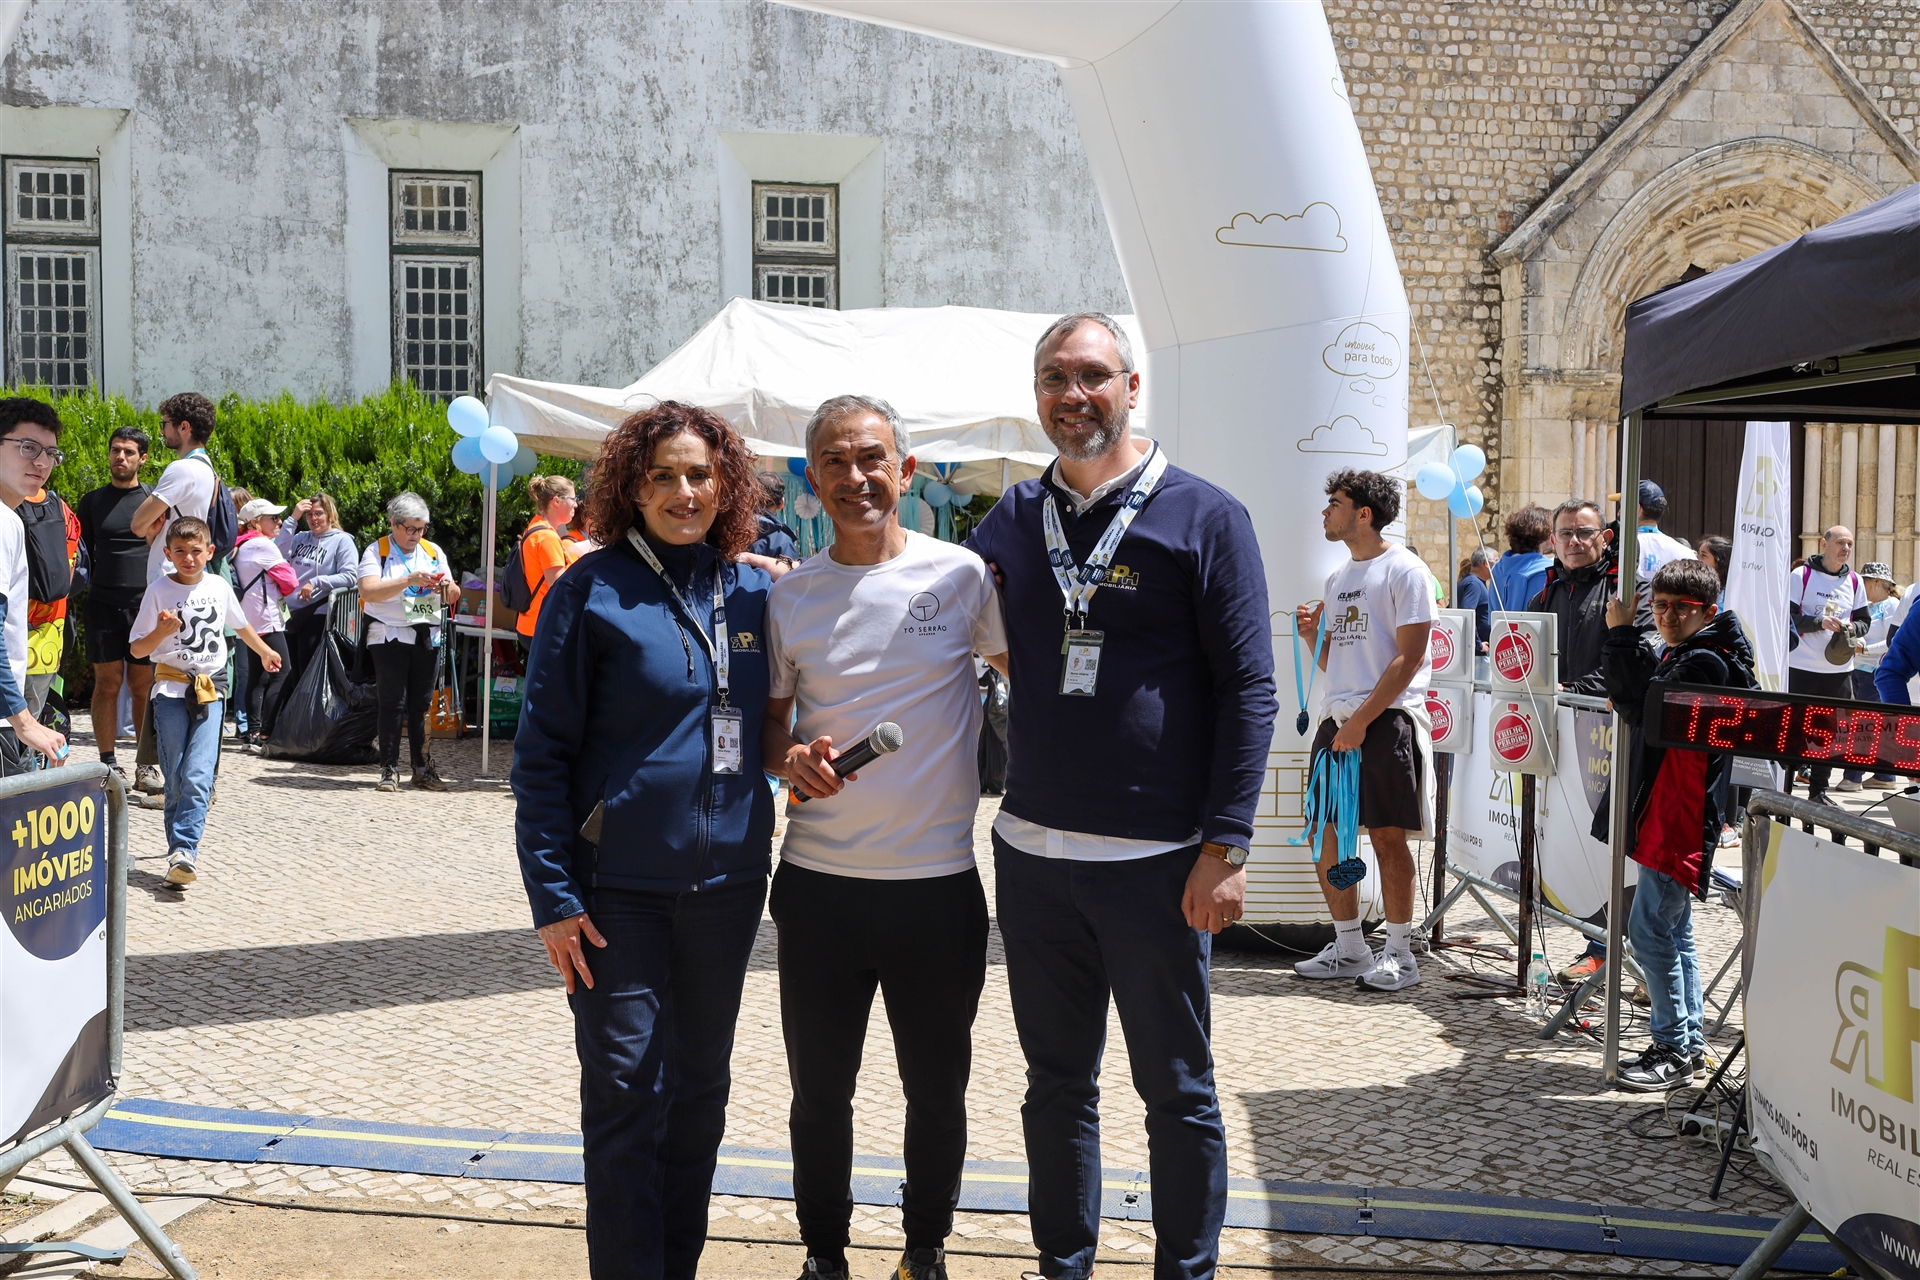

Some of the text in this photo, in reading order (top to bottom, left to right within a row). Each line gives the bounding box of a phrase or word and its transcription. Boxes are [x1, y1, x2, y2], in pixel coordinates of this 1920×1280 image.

[1344, 353, 1393, 367] para todos
[176, 596, 217, 609] CARIOCA
[412, 603, 434, 615] 463
[918, 624, 948, 633] SERRÃO
[1497, 725, 1523, 738] TRILHO
[1497, 733, 1528, 748] PERDIDO
[11, 796, 95, 849] +1000
[13, 845, 93, 896] IMÓVEIS
[14, 879, 93, 924] ANGARIADOS
[1775, 1109, 1791, 1138] AQUI
[1792, 1124, 1808, 1154] POR
[1809, 1139, 1818, 1161] SI
[1867, 1148, 1902, 1179] REAL
